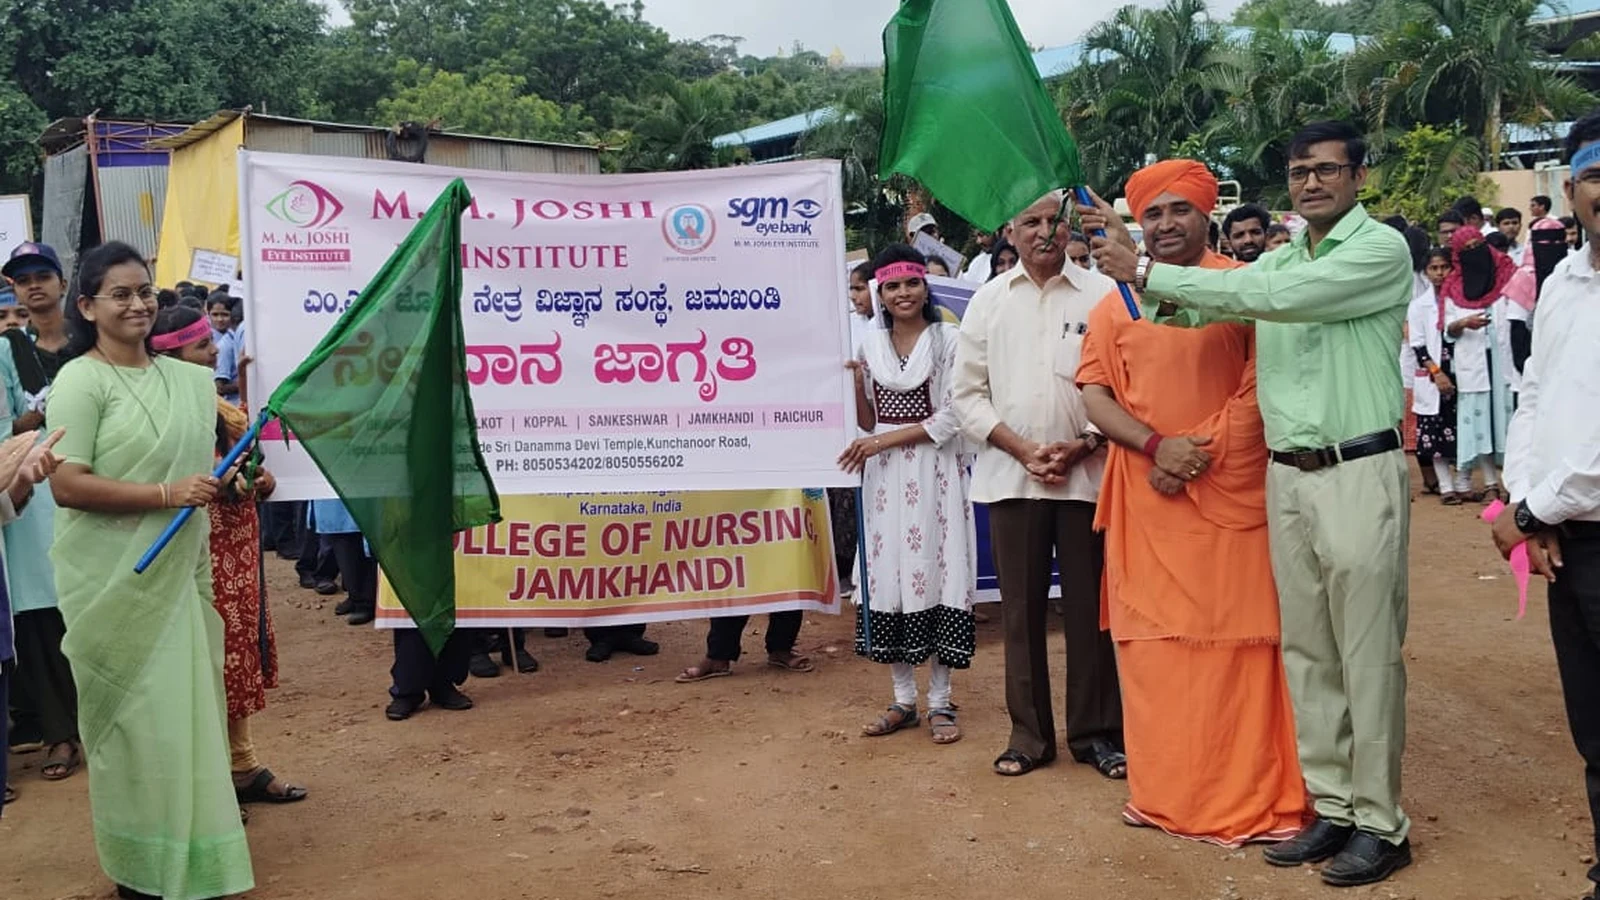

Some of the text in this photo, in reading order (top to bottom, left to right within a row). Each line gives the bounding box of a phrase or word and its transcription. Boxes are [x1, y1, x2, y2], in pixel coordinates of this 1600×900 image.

[371, 188, 424, 219] M.
[511, 198, 655, 230] JOSHI
[727, 197, 789, 227] sgm
[261, 231, 350, 247] M. M. JOSHI
[267, 251, 346, 262] EYE INSTITUTE
[461, 244, 628, 269] INSTITUTE
[474, 285, 522, 322] ನೇತ್ರ
[536, 286, 602, 327] ವಿಜ್ಞಾನ
[615, 283, 673, 327] ಸಂಸ್ಥೆ,
[685, 284, 781, 311] ಜಮಖಂಡಿ
[594, 327, 757, 402] ಜಾಗೃತಿ
[523, 415, 568, 428] KOPPAL
[588, 413, 668, 428] SANKESHWAR
[687, 411, 754, 426] JAMKHANDI
[774, 410, 824, 424] RAICHUR
[495, 440, 511, 453] Sri
[514, 439, 572, 453] Danamma
[575, 437, 600, 451] Devi
[603, 434, 716, 453] Temple,Kunchanoor
[718, 433, 752, 449] Road,
[496, 459, 519, 472] PH:
[522, 454, 685, 472] 8050534202/8050556202
[579, 499, 682, 516] Karnataka, India
[453, 505, 819, 558] LLEGE OF NURSING,
[508, 555, 746, 602] JAMKHANDI
